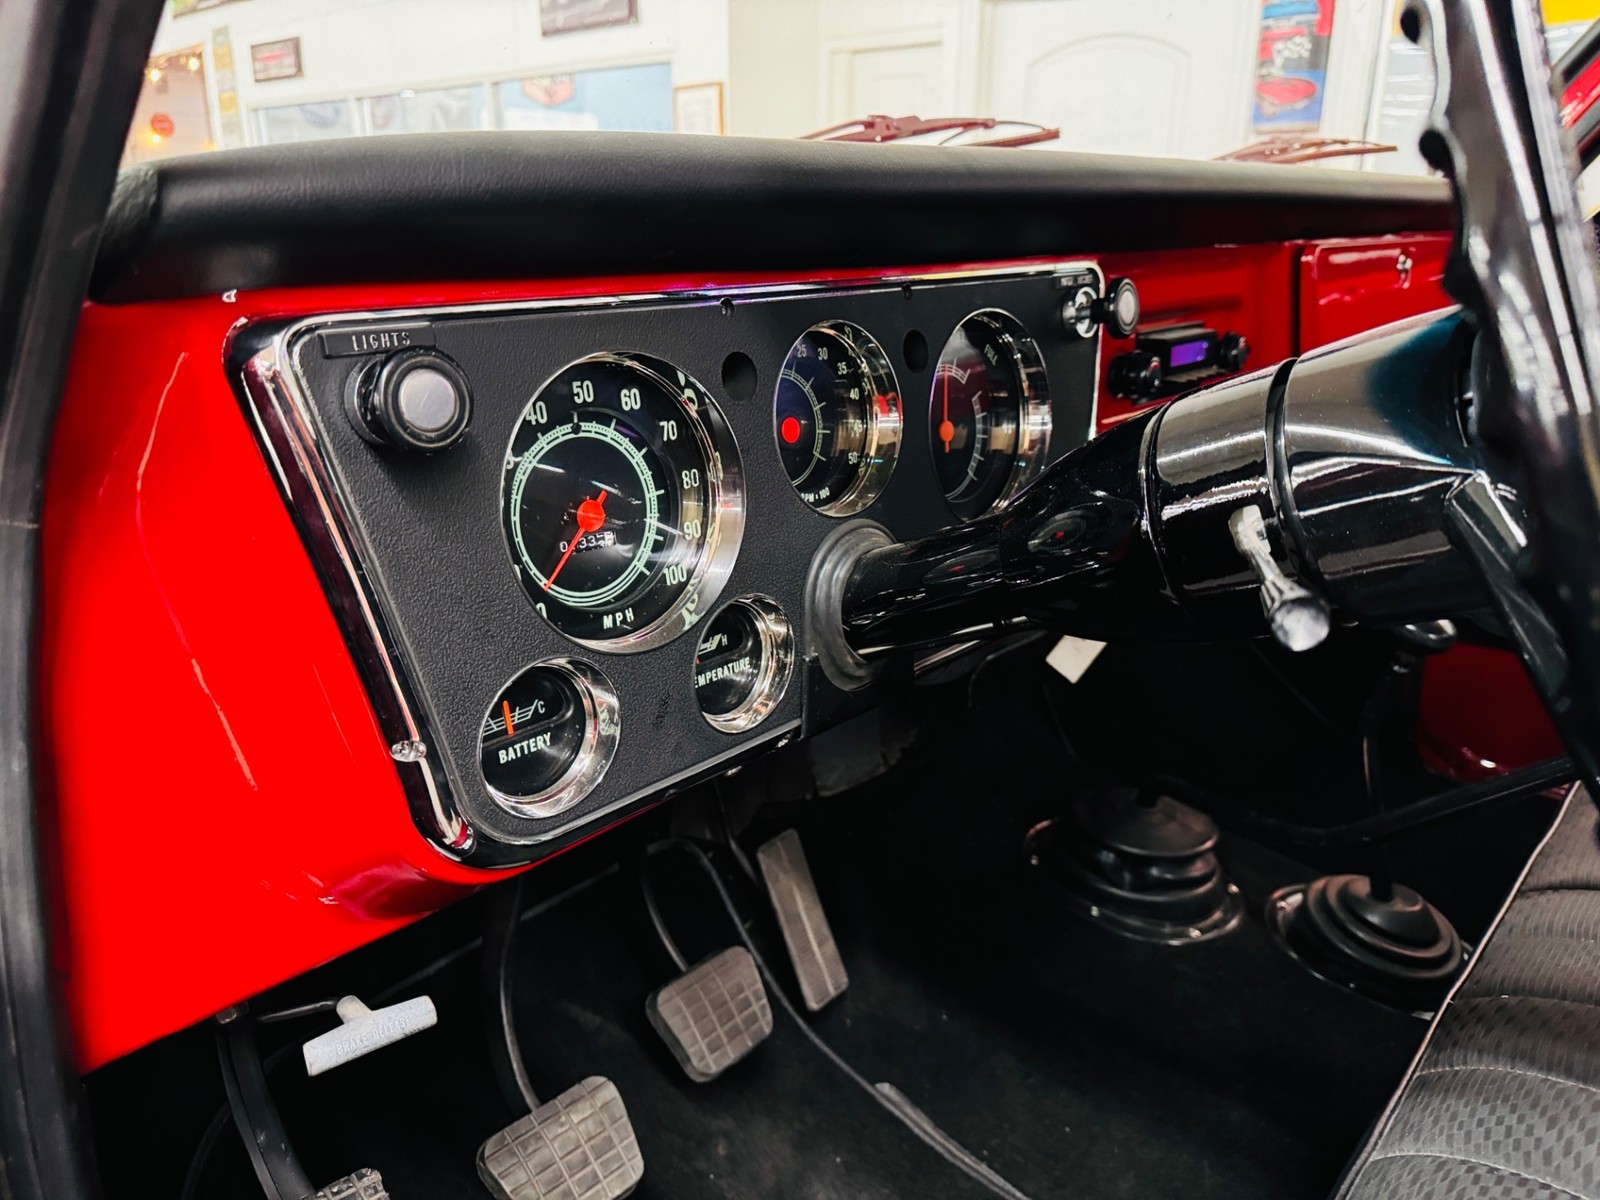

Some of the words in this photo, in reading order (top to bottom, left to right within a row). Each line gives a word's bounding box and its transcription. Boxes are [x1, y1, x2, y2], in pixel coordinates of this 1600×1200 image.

[352, 331, 410, 352] LIGHTS
[797, 344, 807, 358] 25
[817, 347, 828, 360] 30
[837, 361, 848, 375] 35
[572, 380, 594, 404] 50
[620, 388, 641, 411] 60
[849, 388, 860, 400] 40
[525, 401, 548, 426] 40
[659, 420, 678, 442] 70
[848, 452, 858, 465] 50
[682, 468, 700, 490] 80
[684, 519, 702, 541] 90
[665, 565, 688, 586] 100
[603, 607, 635, 630] MPH
[721, 634, 728, 646] H
[537, 701, 545, 714] C
[498, 732, 551, 764] BATTERY
[336, 1032, 367, 1054] BRAKE
